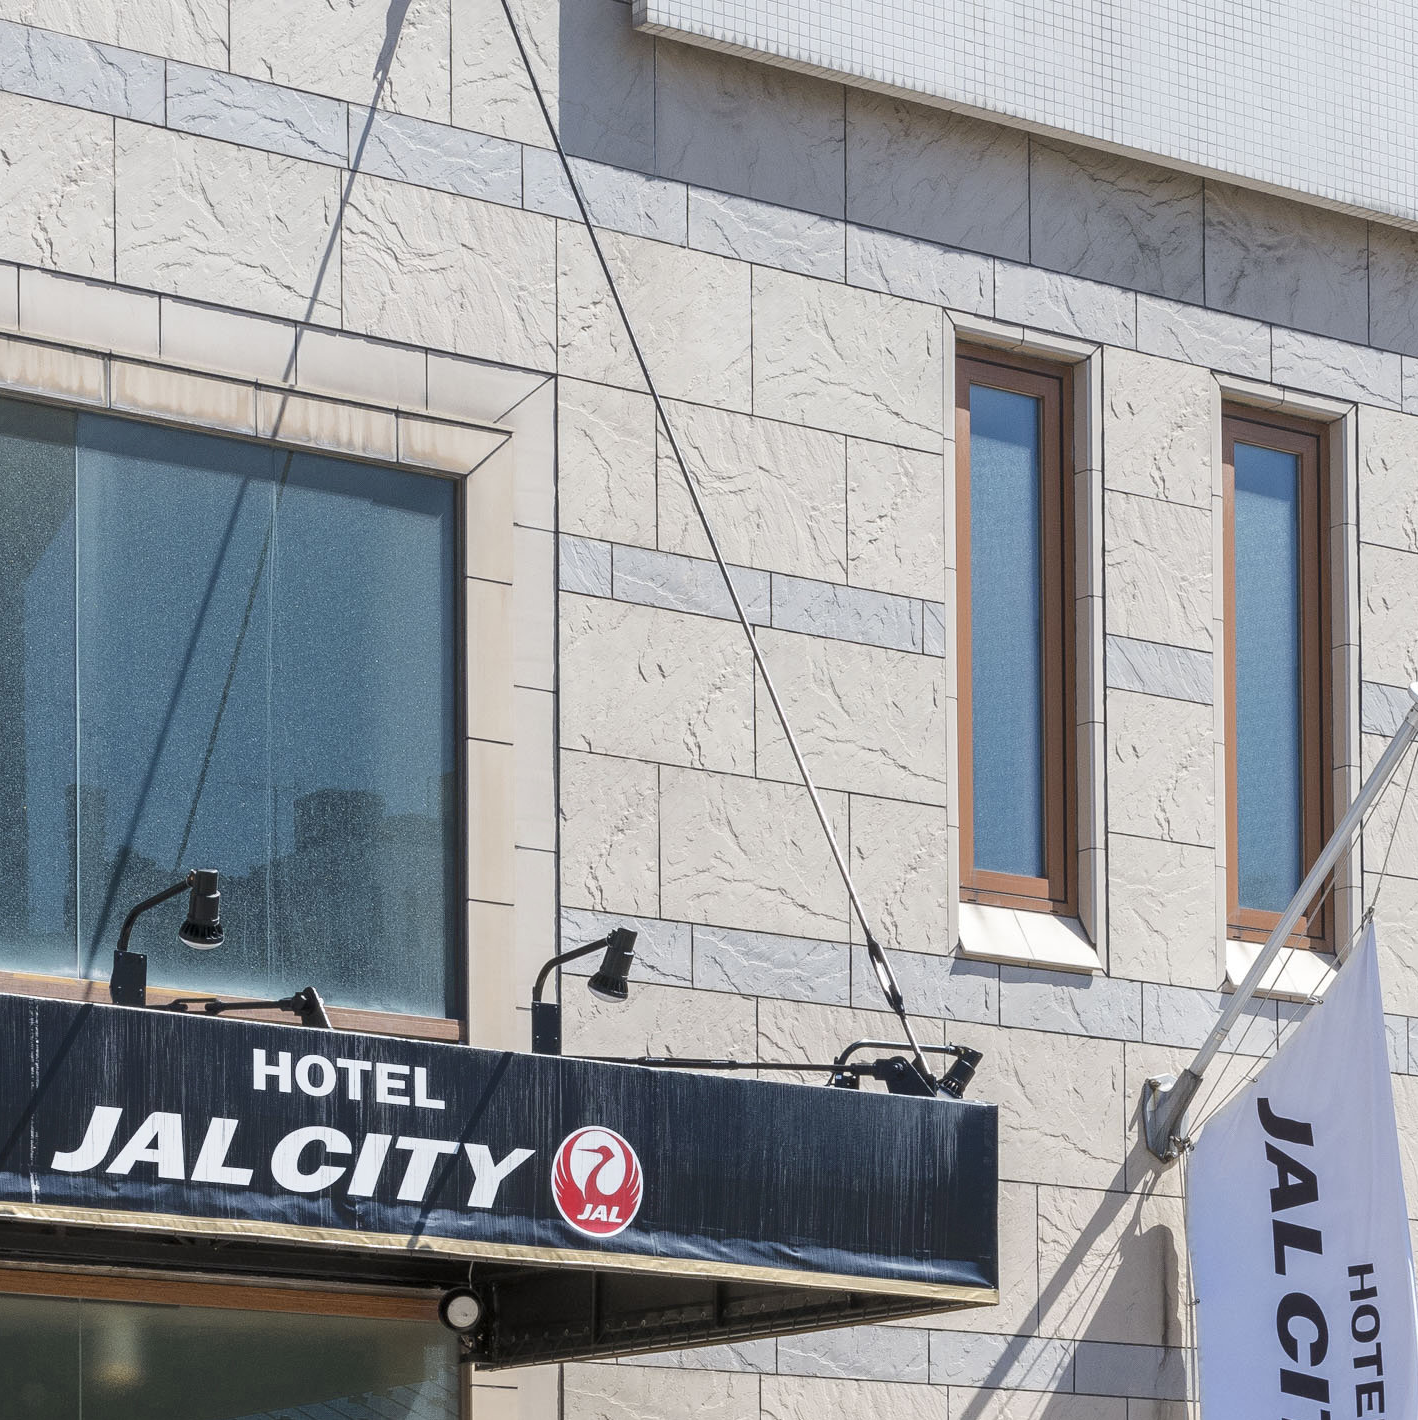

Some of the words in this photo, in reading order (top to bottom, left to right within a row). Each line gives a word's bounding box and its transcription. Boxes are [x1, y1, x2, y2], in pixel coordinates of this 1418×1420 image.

[252, 1048, 446, 1110] HOTEL
[51, 1105, 254, 1186] JAL
[270, 1125, 536, 1209] CITY
[1257, 1097, 1323, 1276] JAL
[576, 1203, 623, 1223] JAL
